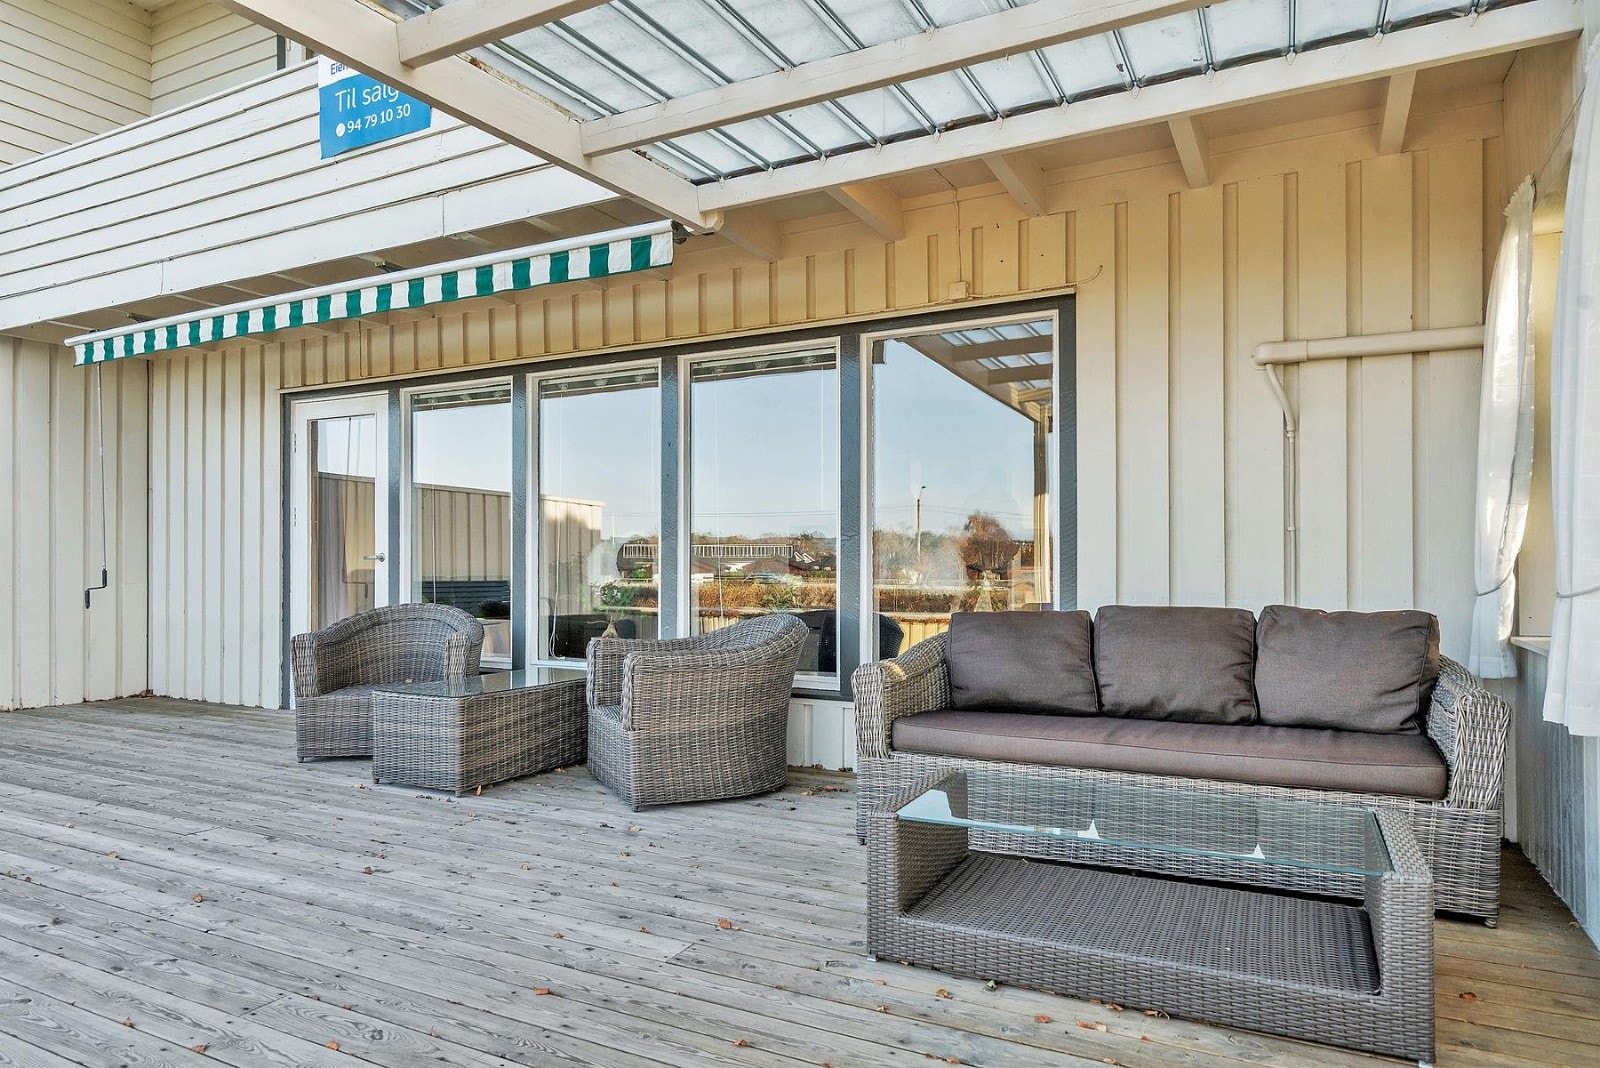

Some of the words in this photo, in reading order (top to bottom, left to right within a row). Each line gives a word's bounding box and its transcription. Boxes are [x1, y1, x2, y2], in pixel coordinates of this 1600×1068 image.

[335, 87, 357, 113] Til
[362, 84, 399, 106] salg
[347, 118, 362, 133] 94
[364, 113, 378, 129] 79
[380, 108, 394, 124] 10
[396, 103, 411, 119] 30
